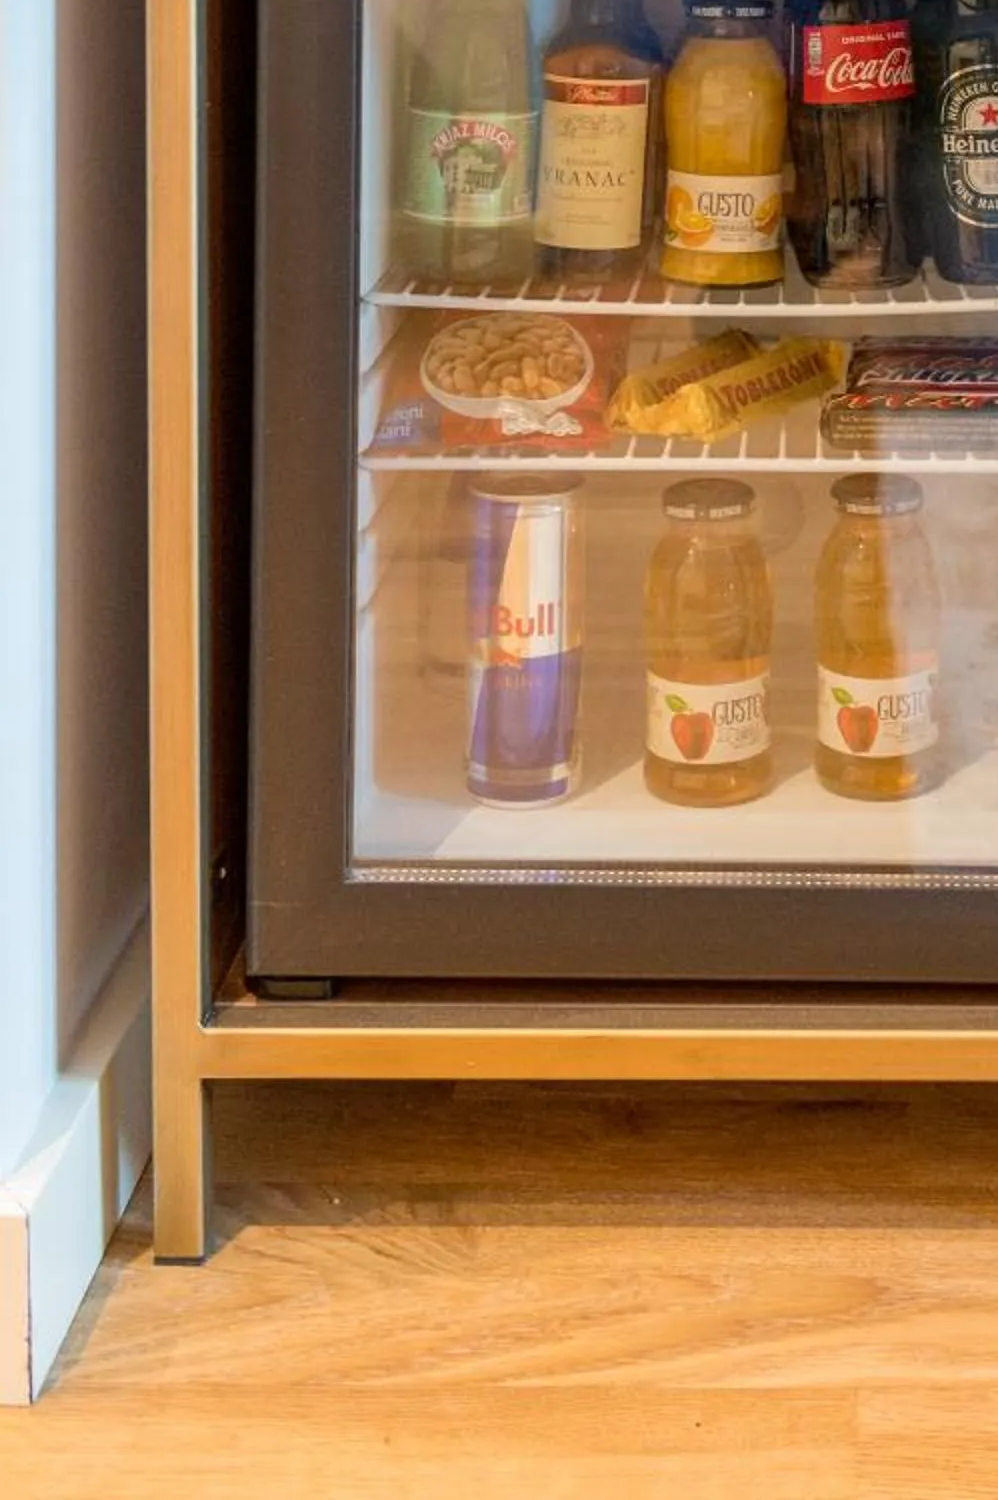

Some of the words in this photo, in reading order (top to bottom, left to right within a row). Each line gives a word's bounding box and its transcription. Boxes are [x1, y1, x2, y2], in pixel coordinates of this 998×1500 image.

[947, 80, 989, 121] HEINEKEN
[697, 191, 755, 218] GUSTO
[491, 602, 555, 638] Bull
